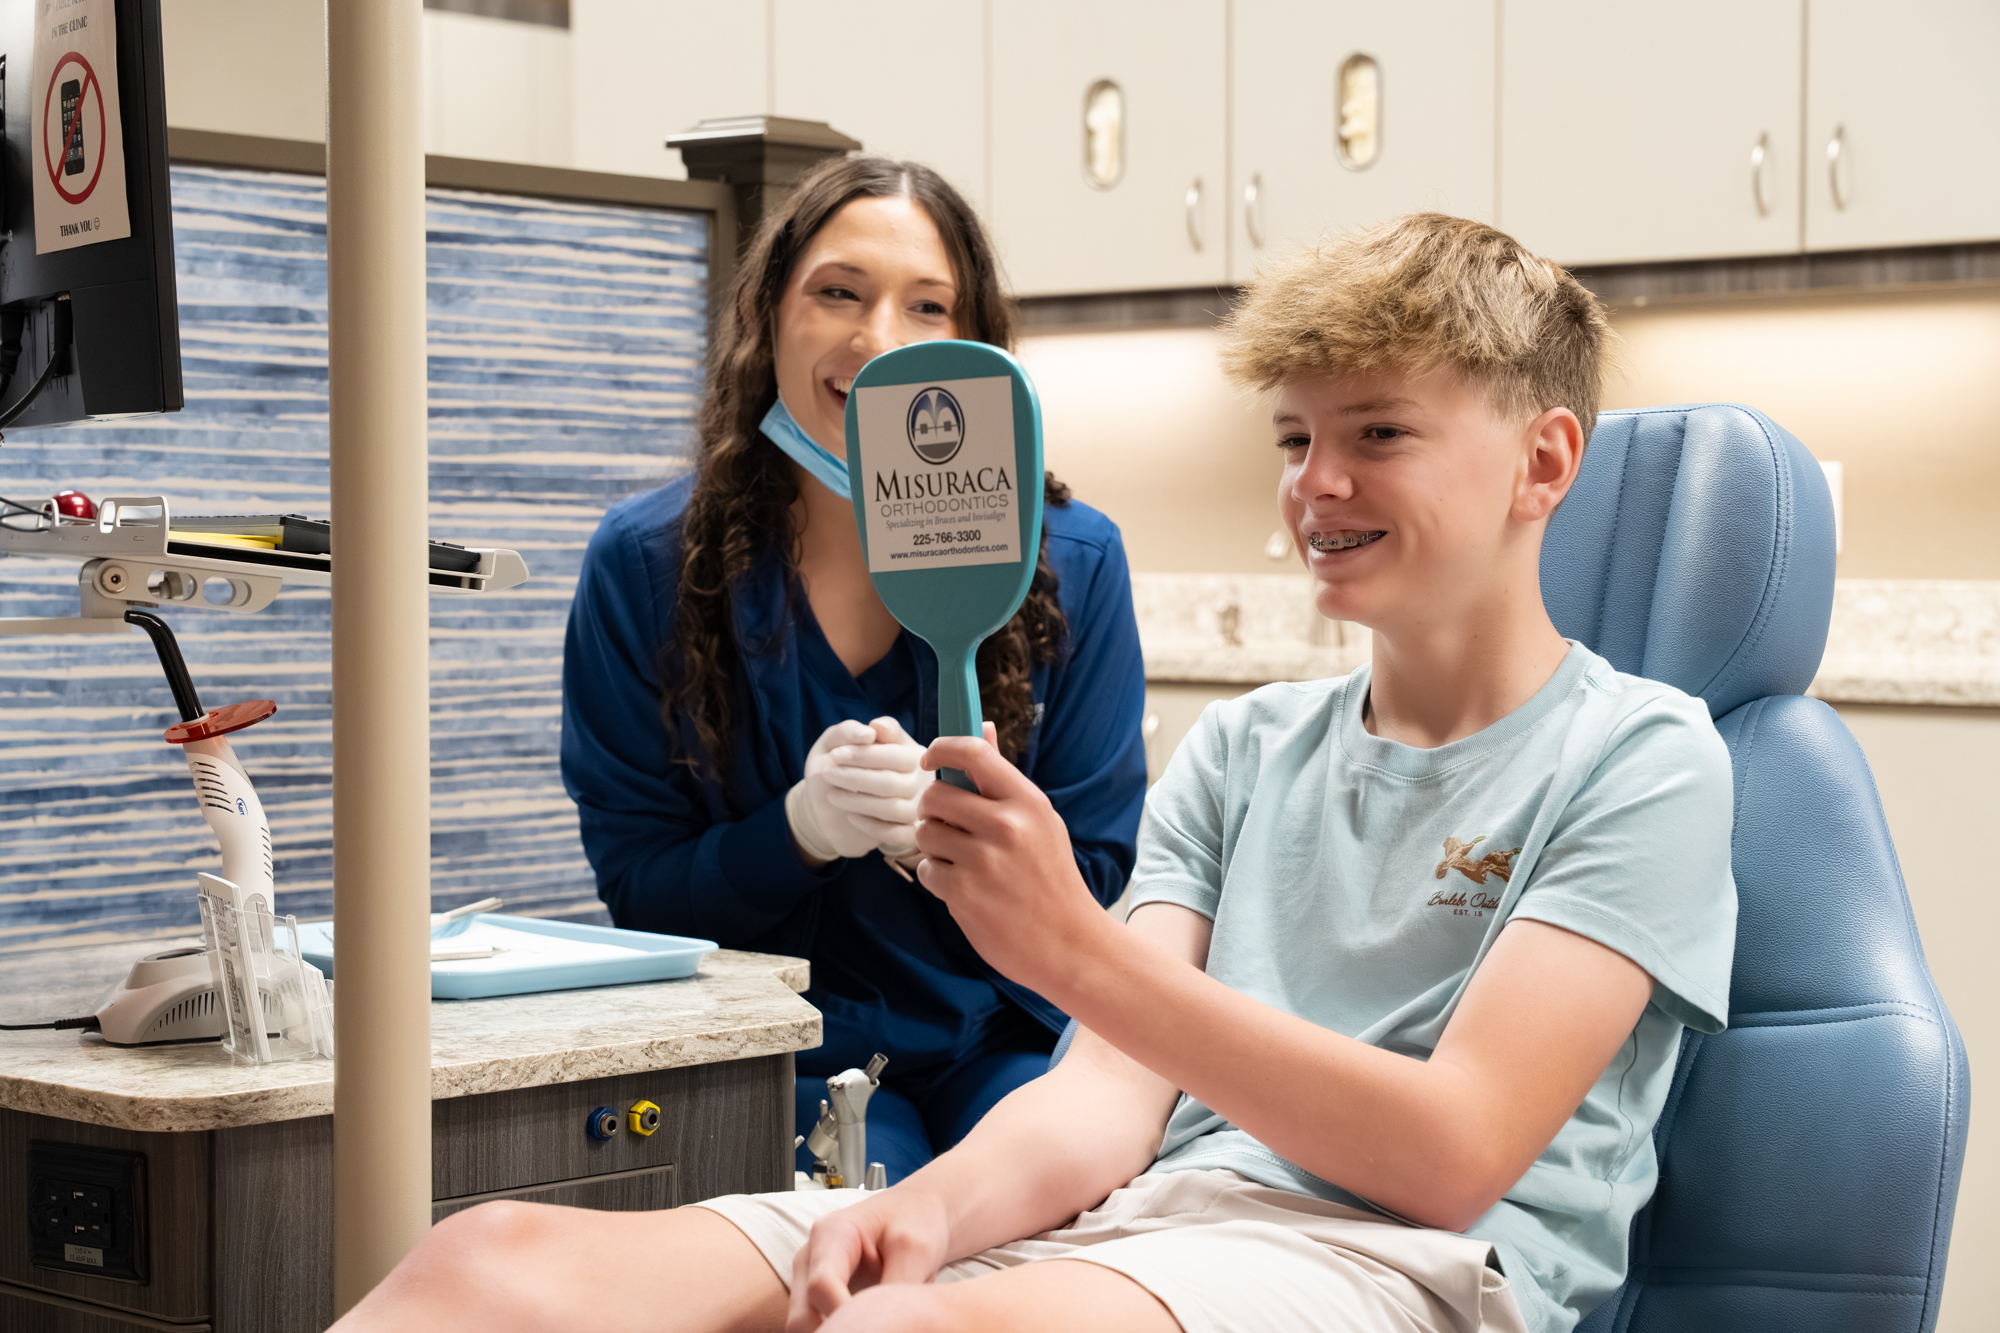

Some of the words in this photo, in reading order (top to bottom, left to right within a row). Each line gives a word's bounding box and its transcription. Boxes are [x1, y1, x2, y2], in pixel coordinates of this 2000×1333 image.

[58, 22, 68, 36] THE
[69, 15, 88, 32] CLINIC
[60, 223, 79, 237] THANK
[80, 220, 92, 232] YOU
[874, 466, 1013, 503] MISURACA
[881, 493, 1009, 518] ORTHODONTICS
[885, 517, 925, 531] Specializing
[926, 517, 933, 526] in
[935, 515, 957, 525] Braces
[957, 512, 971, 523] and
[972, 510, 1006, 524] Invisalign
[913, 529, 981, 546] 225-766-3300
[890, 543, 1008, 560] www.misuracaorthodontics.com
[1427, 891, 1467, 906] Burlebo
